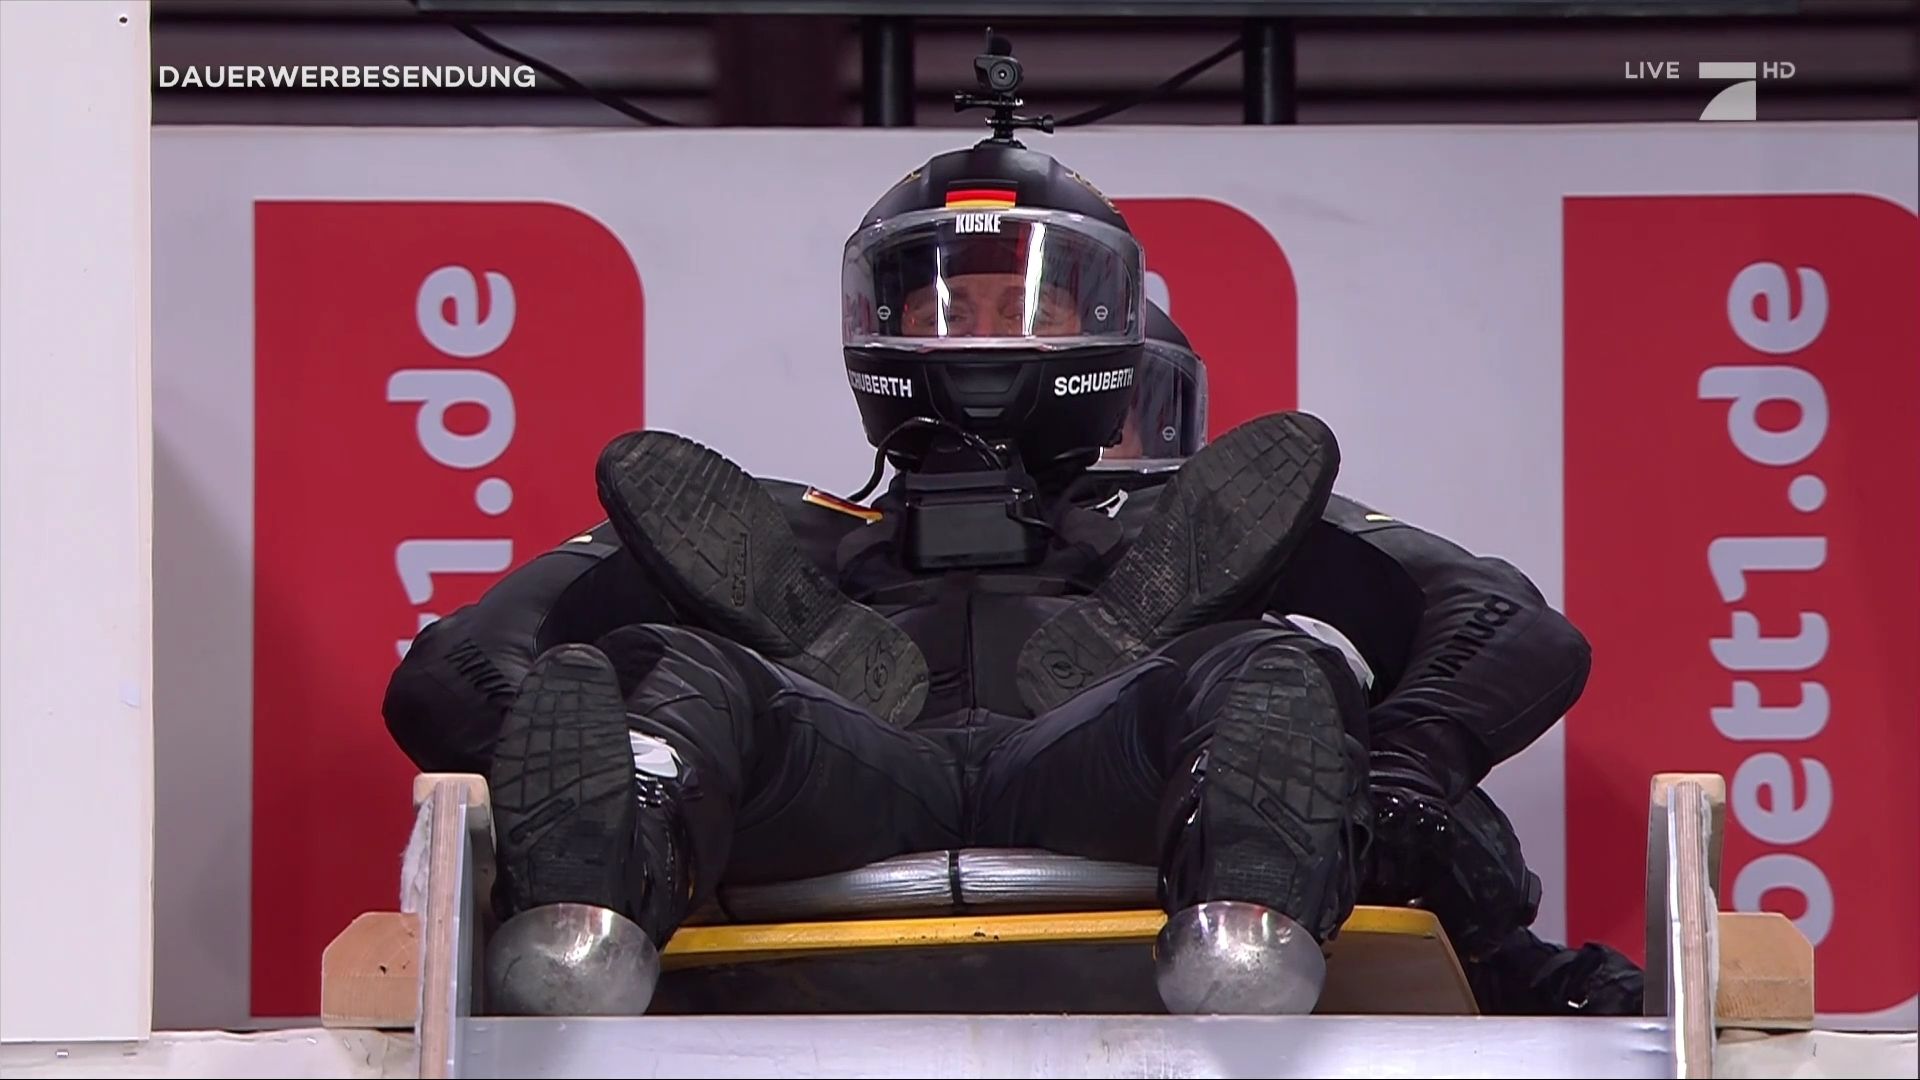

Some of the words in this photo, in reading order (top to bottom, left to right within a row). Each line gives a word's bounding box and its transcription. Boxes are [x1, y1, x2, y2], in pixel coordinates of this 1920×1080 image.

[955, 212, 1001, 234] KUSKE
[1054, 367, 1134, 396] SCHUBERTH
[387, 266, 516, 662] 1.de
